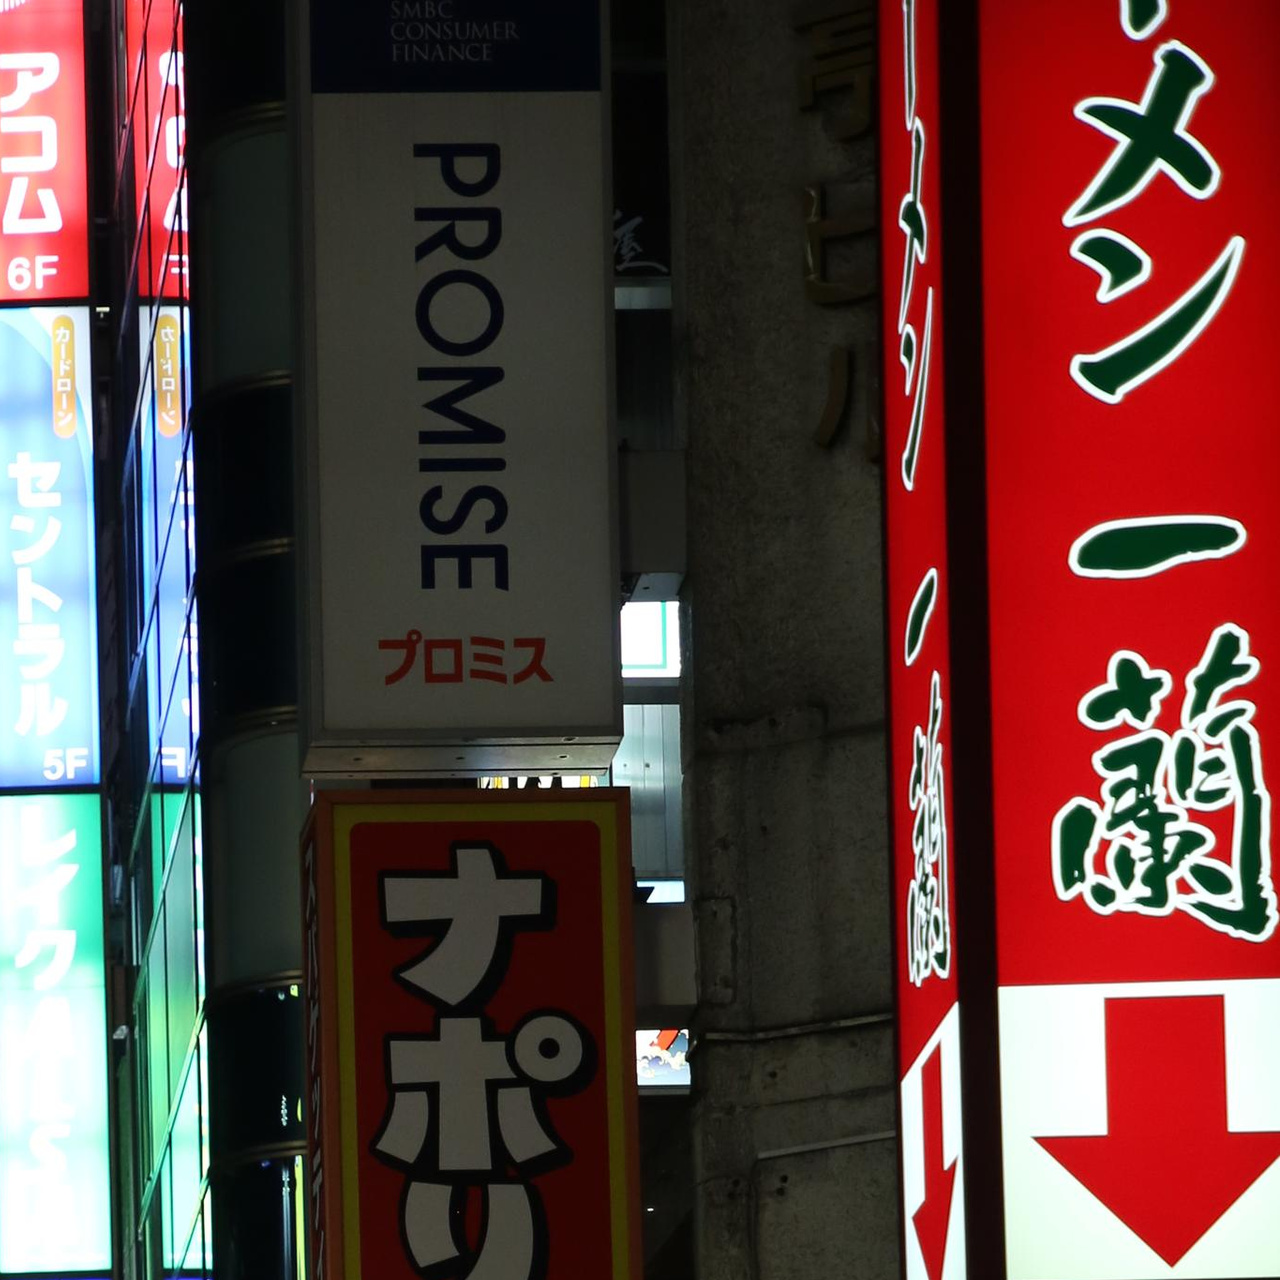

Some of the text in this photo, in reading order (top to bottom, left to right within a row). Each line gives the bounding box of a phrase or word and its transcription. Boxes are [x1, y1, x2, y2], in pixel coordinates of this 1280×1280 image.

[390, 22, 521, 41] CONSUMER
[391, 43, 492, 63] FINANCE
[7, 256, 59, 291] 6F
[56, 324, 74, 427] カードローン
[413, 143, 510, 592] PROMISE
[1052, 0, 1280, 942] メン 一蘭
[8, 451, 69, 738] セントラル
[377, 629, 554, 687] プロミス
[43, 748, 88, 781] 5F
[15, 803, 81, 991] レイク
